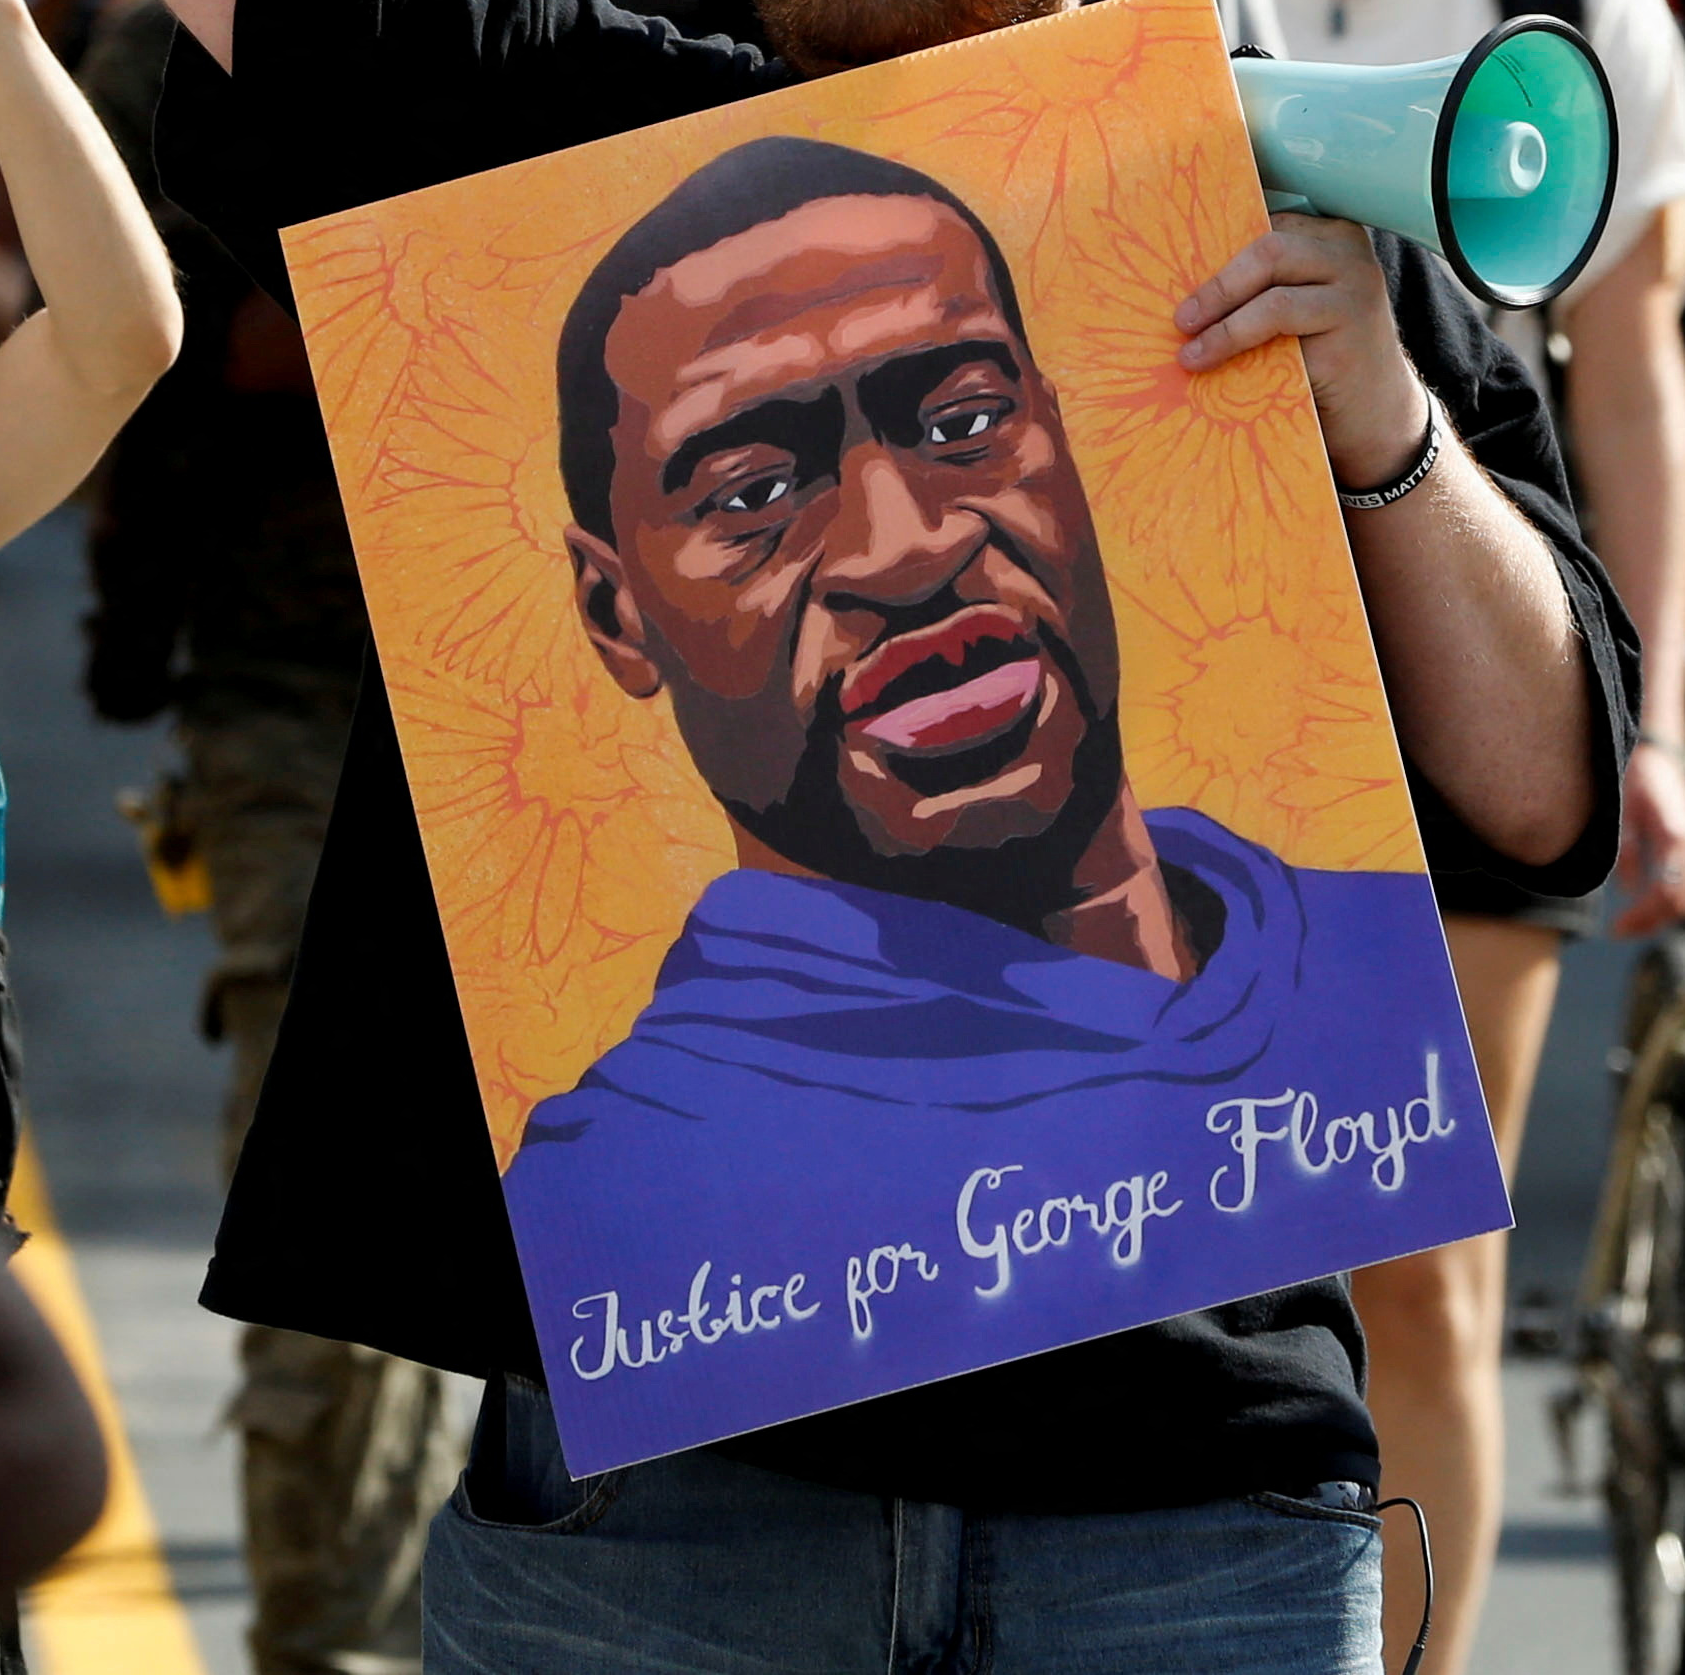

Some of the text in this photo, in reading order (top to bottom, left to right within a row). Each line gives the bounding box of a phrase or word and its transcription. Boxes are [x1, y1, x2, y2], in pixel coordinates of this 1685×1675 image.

[569, 1052, 1457, 1381] Justice for George Floyd
